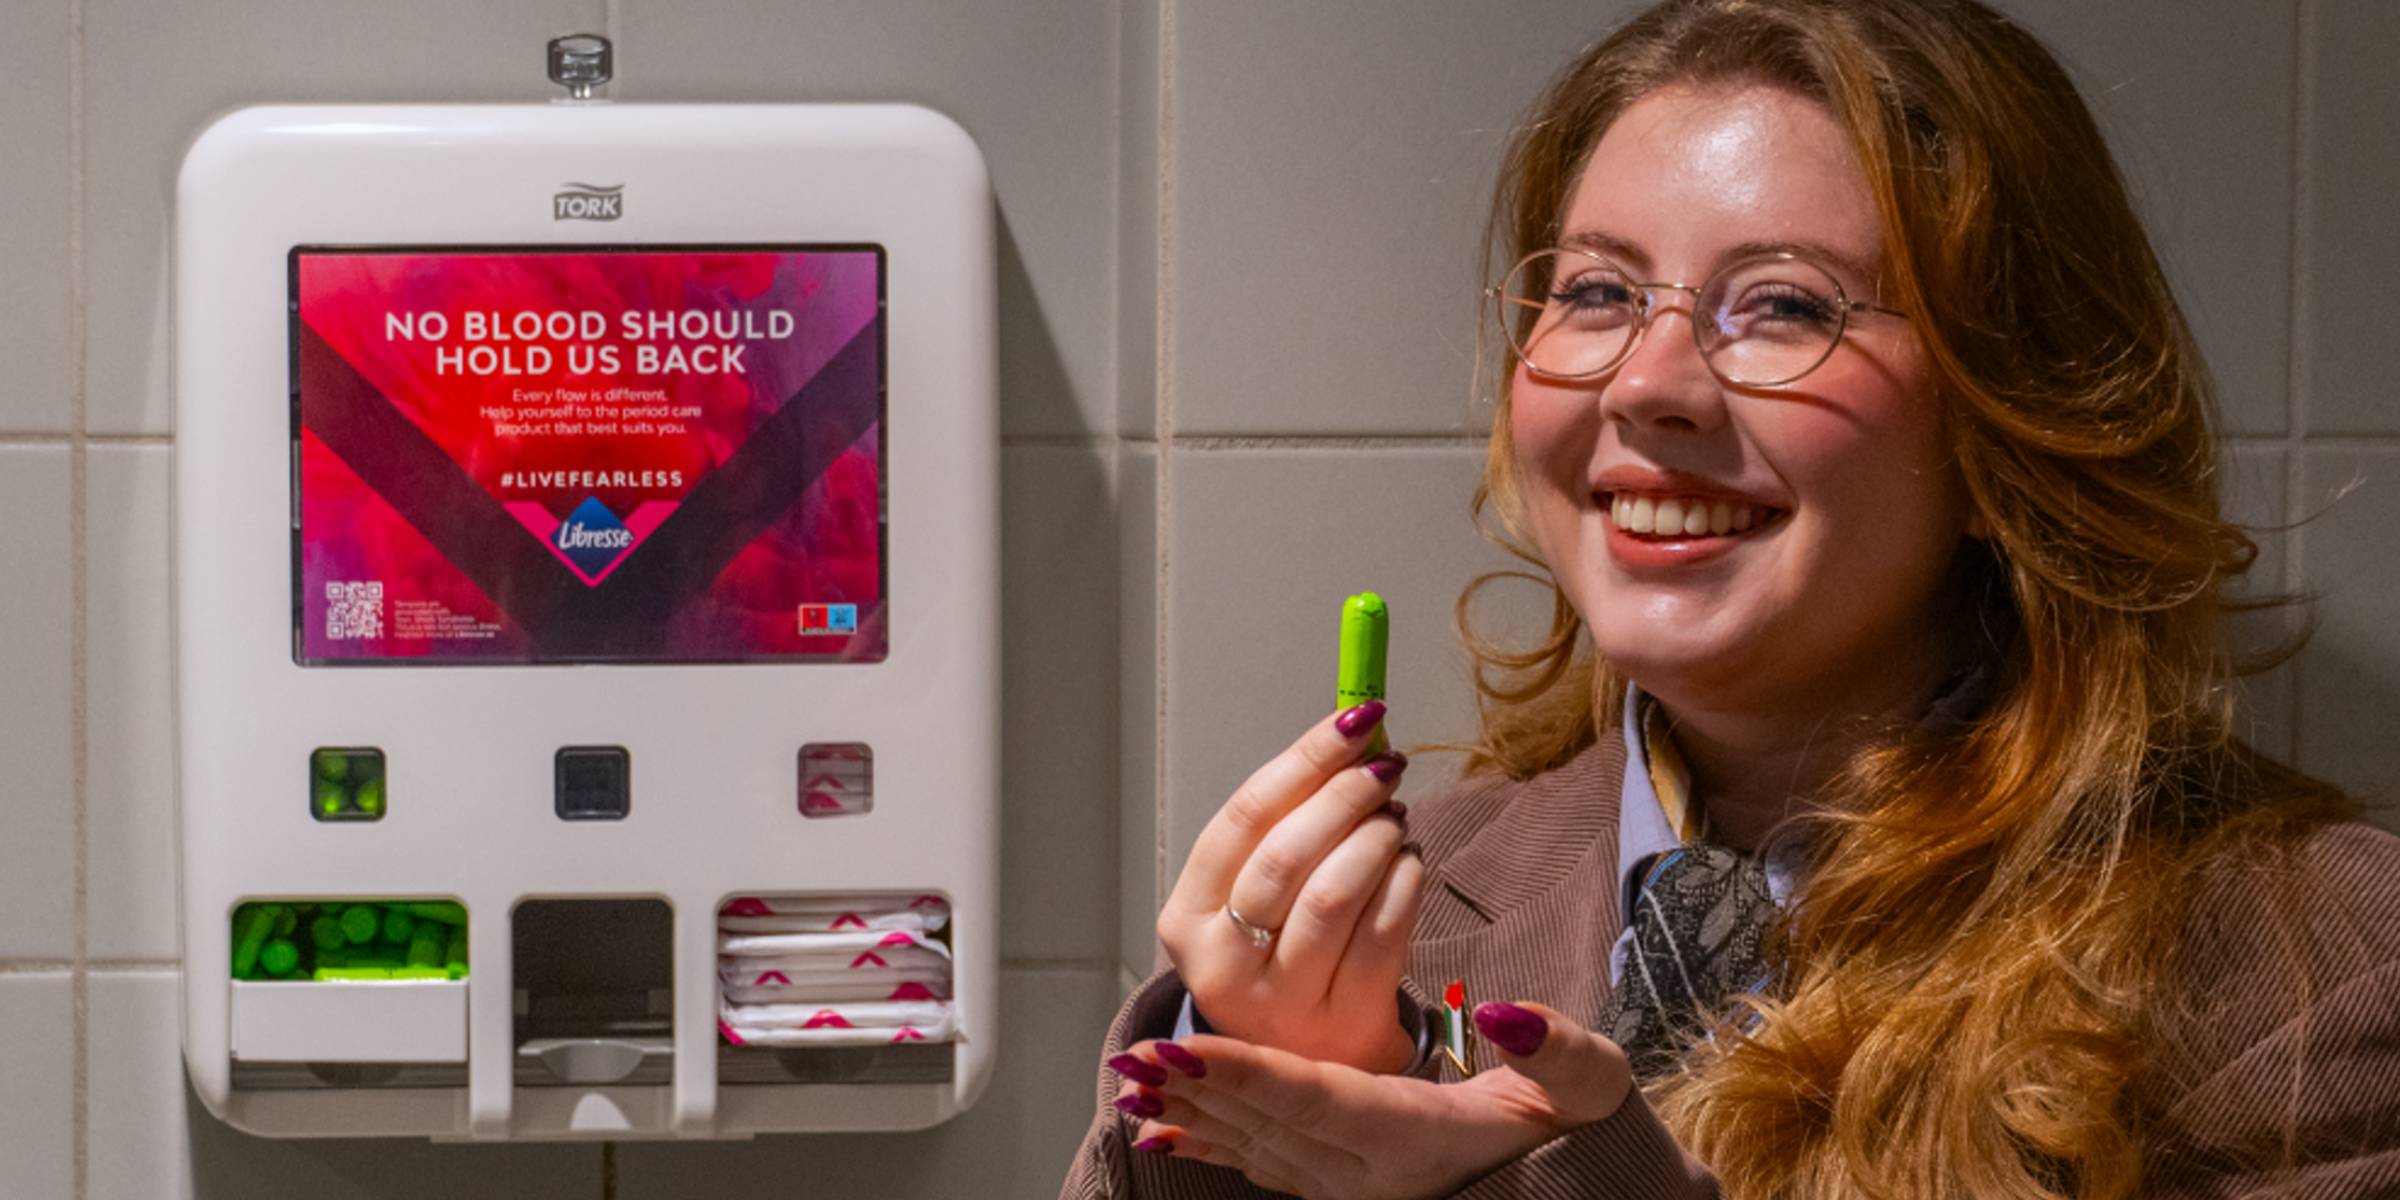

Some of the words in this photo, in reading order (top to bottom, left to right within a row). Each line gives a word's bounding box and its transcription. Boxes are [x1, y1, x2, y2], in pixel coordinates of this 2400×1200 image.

[557, 197, 618, 217] TORK
[385, 311, 448, 341] NO
[464, 311, 607, 340] BLOOD
[622, 310, 795, 339] SHOULD
[436, 346, 552, 375] HOLD
[568, 346, 621, 374] US
[636, 345, 747, 374] BACK
[512, 389, 552, 404] Every
[556, 388, 587, 401] flow
[591, 388, 601, 401] is
[604, 388, 668, 401] different.
[480, 406, 514, 419] Help
[518, 405, 574, 420] yourself
[576, 406, 592, 417] to
[595, 405, 619, 418] the
[622, 405, 668, 419] period
[671, 408, 702, 417] care
[494, 422, 550, 437] product
[554, 422, 583, 434] that
[586, 422, 617, 434] best
[622, 421, 653, 433] suits
[657, 424, 686, 436] you.
[501, 471, 683, 487] #LIVEFEARLESS
[558, 521, 631, 550] Libresse
